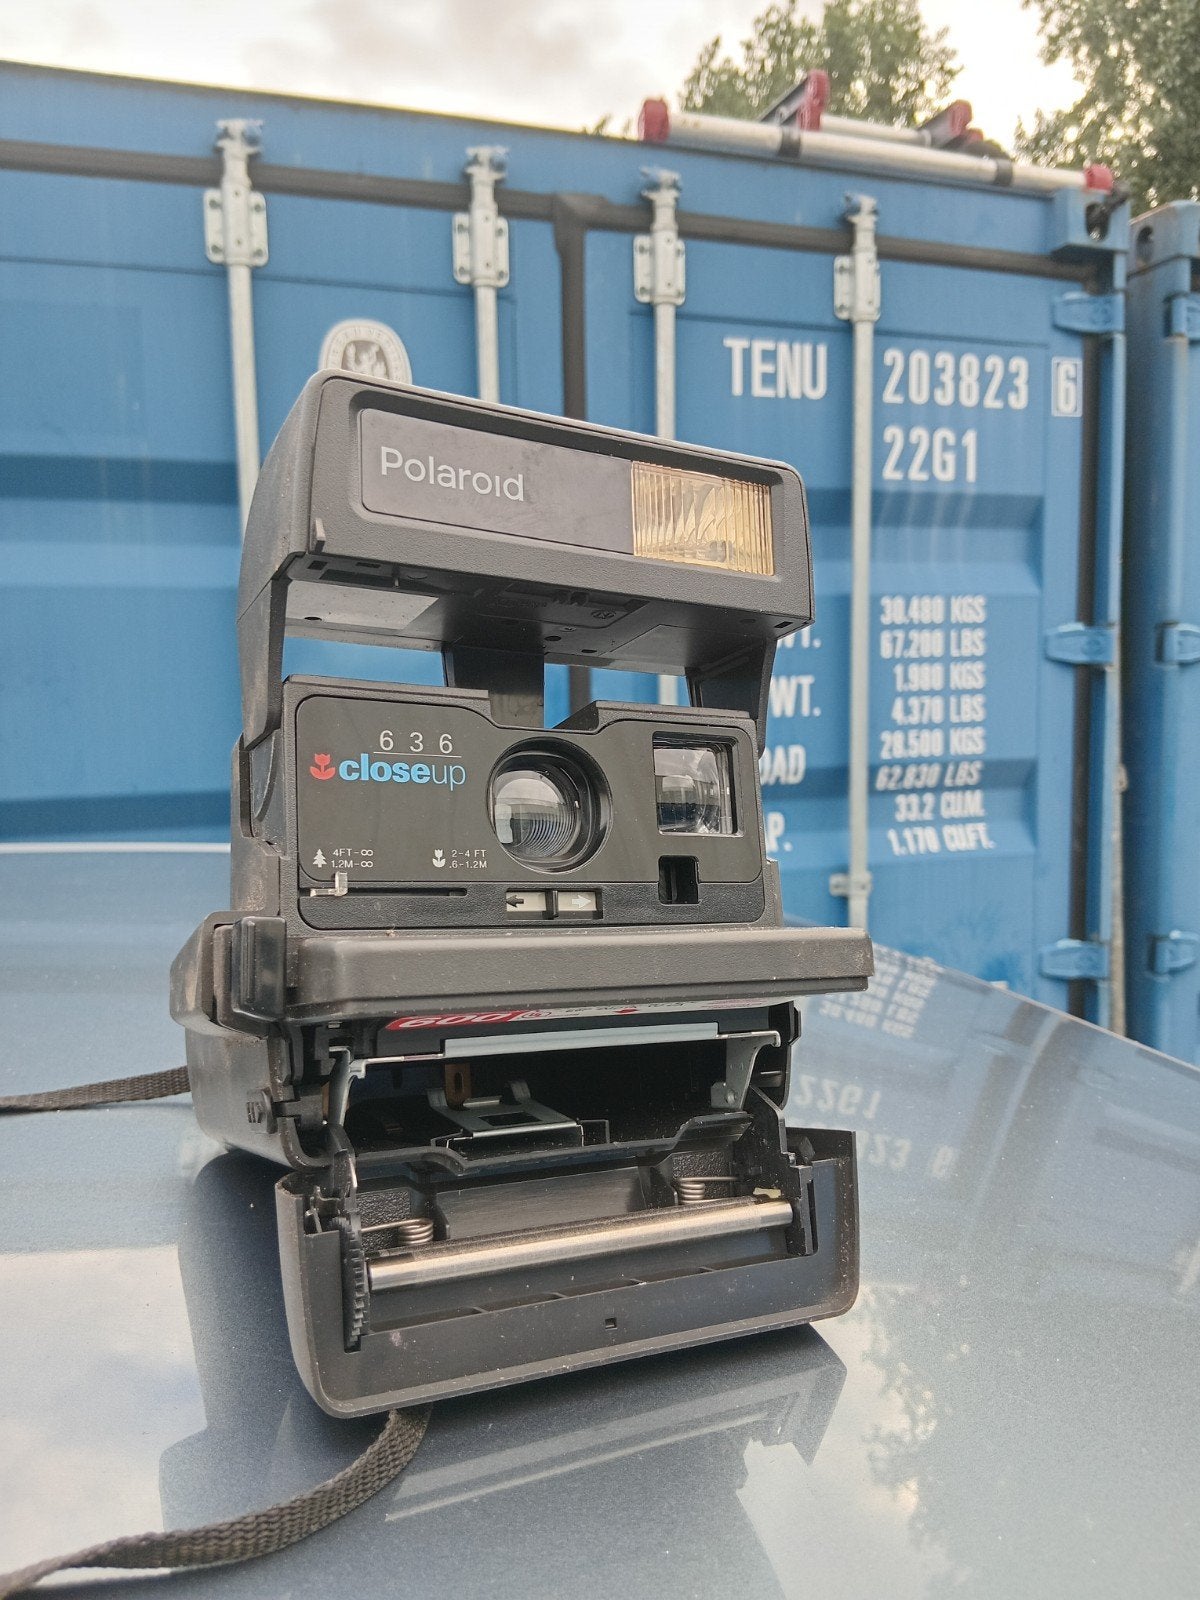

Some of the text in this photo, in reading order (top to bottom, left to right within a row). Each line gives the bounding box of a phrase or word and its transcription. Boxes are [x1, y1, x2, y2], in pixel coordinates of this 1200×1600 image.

[723, 338, 1078, 414] TENU 203823 6
[882, 425, 978, 483] 22G1
[381, 446, 524, 501] Polaroid
[950, 594, 986, 624] KGS
[950, 627, 986, 657] LBS
[949, 660, 985, 690] KGS
[949, 693, 985, 723] LBS
[949, 726, 985, 756] KGS
[339, 753, 466, 791] closeup
[944, 760, 983, 787] LBS
[474, 849, 487, 858] FT
[399, 1013, 512, 1028] 600
